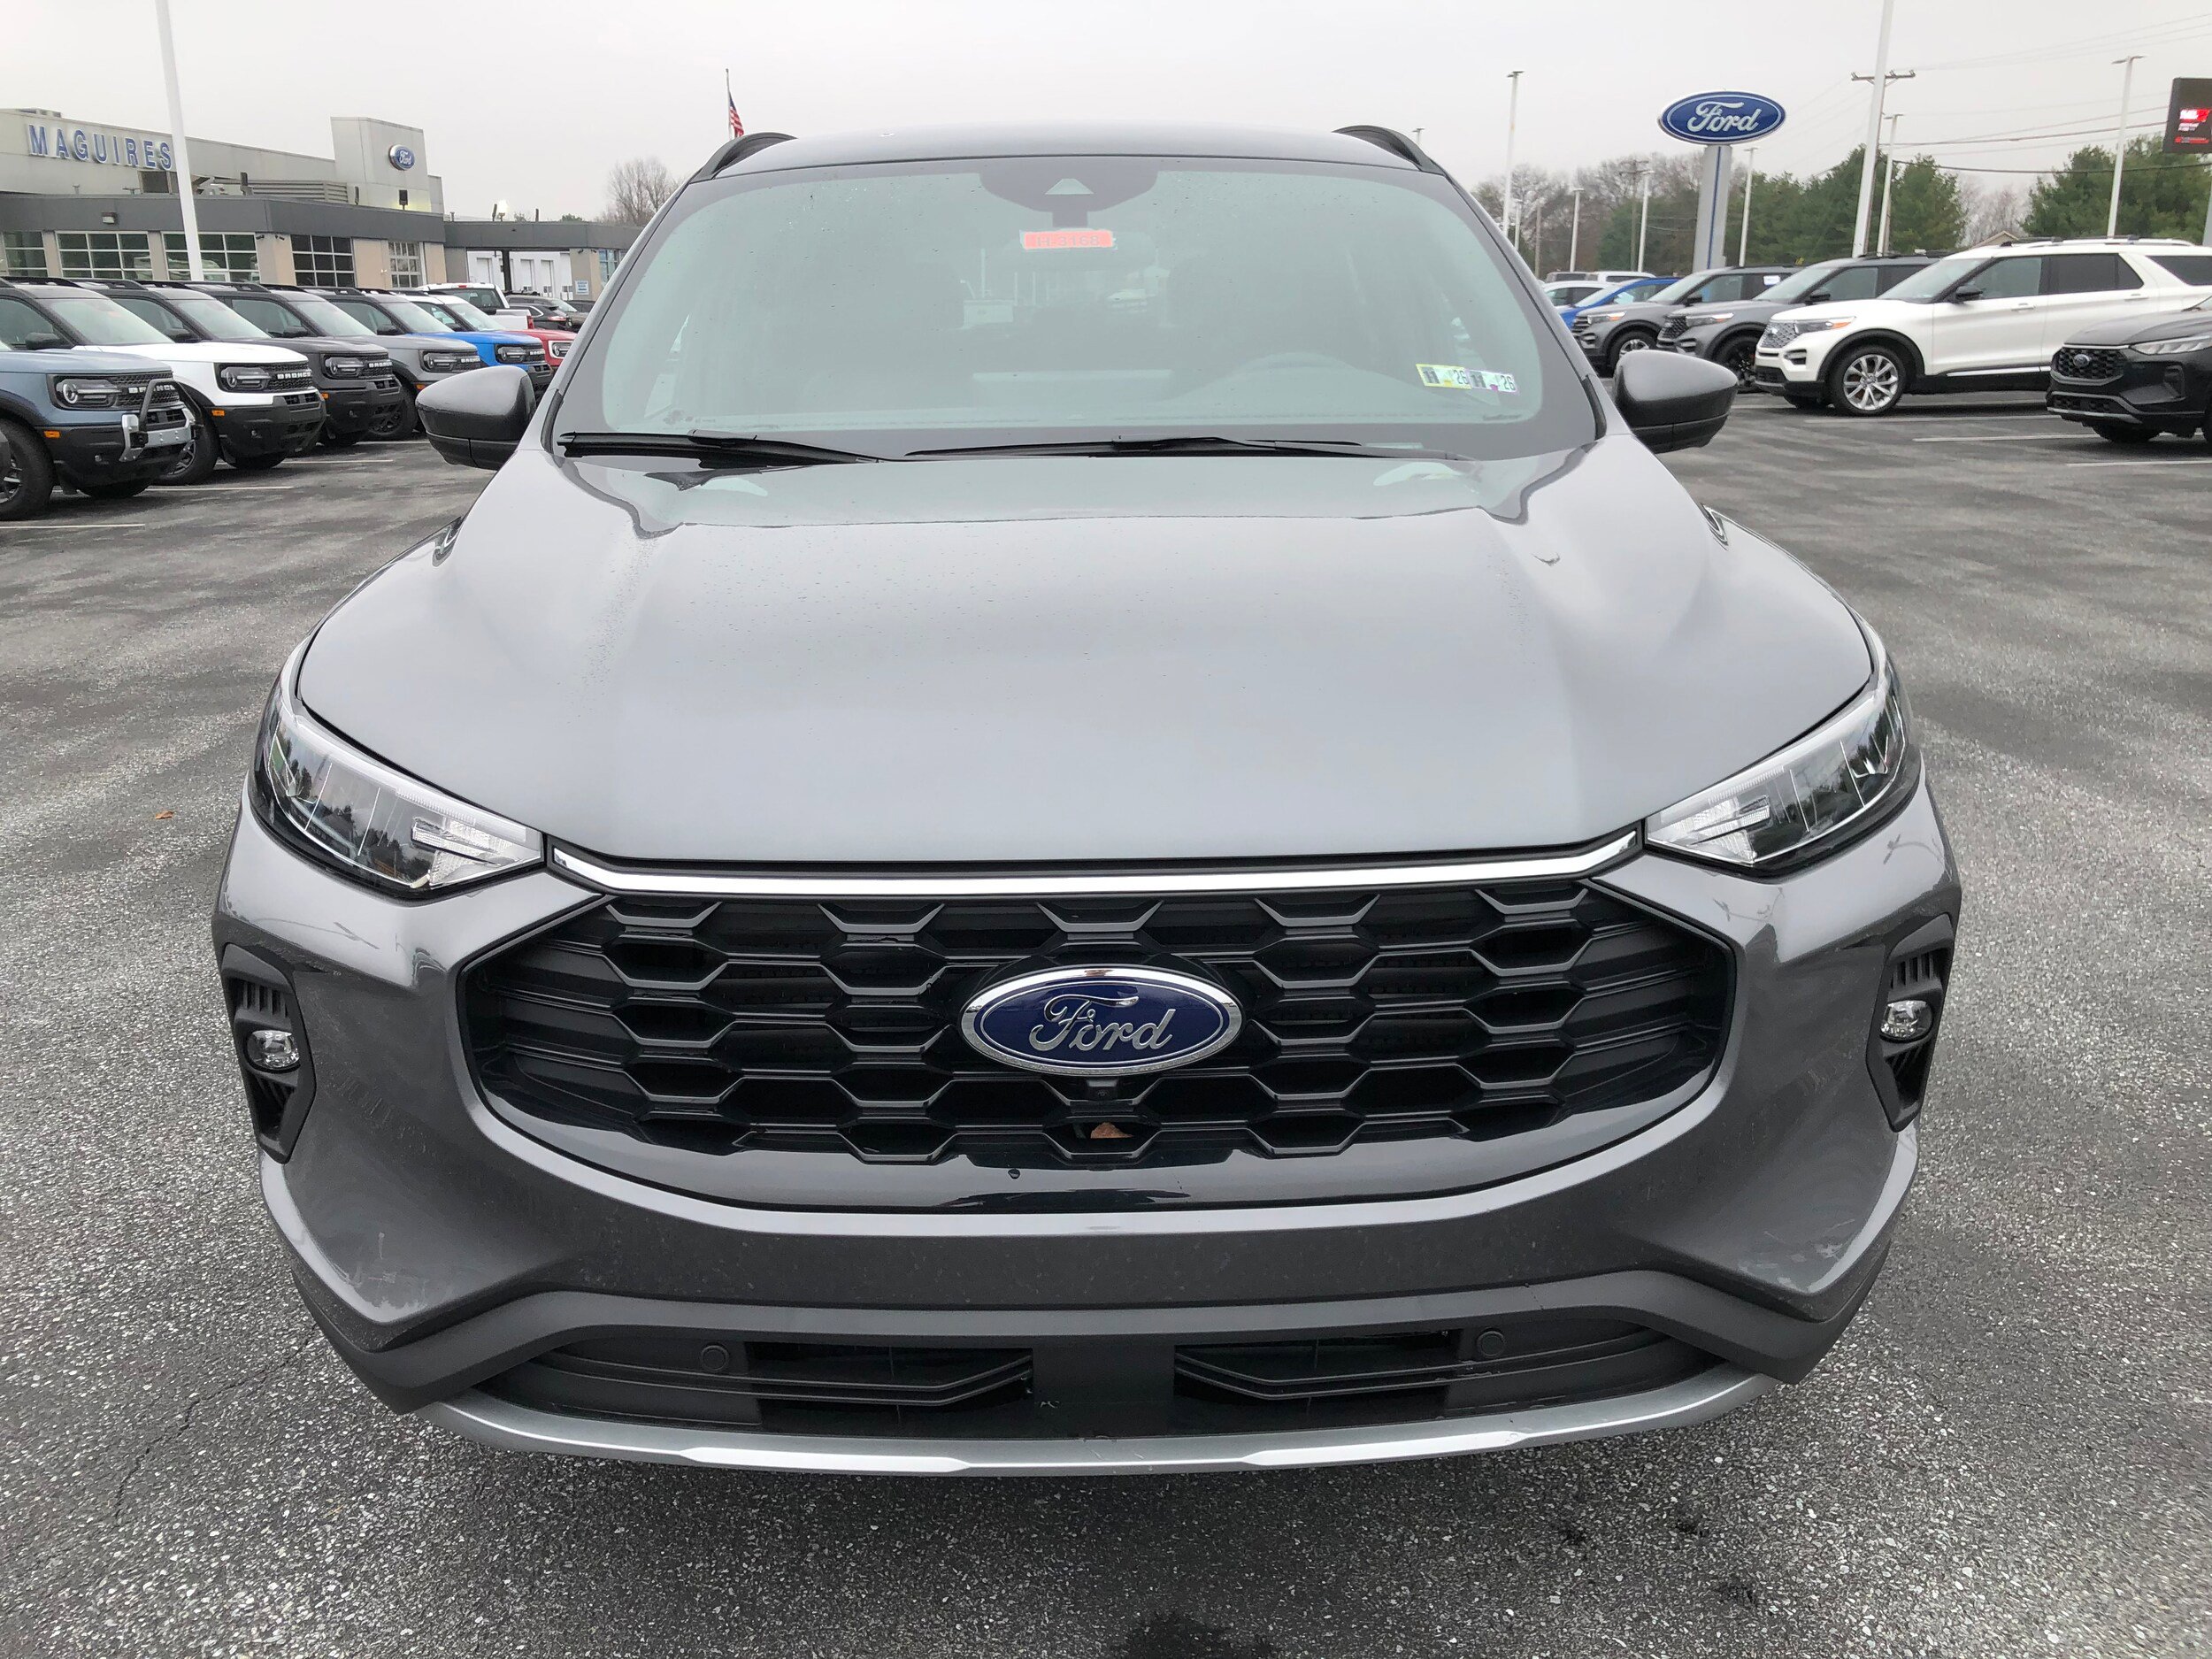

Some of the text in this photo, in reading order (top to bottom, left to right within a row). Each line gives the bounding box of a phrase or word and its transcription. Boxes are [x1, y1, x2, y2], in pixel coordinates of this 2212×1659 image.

[1686, 101, 1763, 133] Ford
[28, 124, 173, 170] MAGUIRES
[398, 150, 412, 165] Ford
[1036, 234, 1101, 247] H-3168
[1453, 369, 1470, 385] 26
[1501, 374, 1517, 391] 26
[1028, 994, 1177, 1051] Ford
